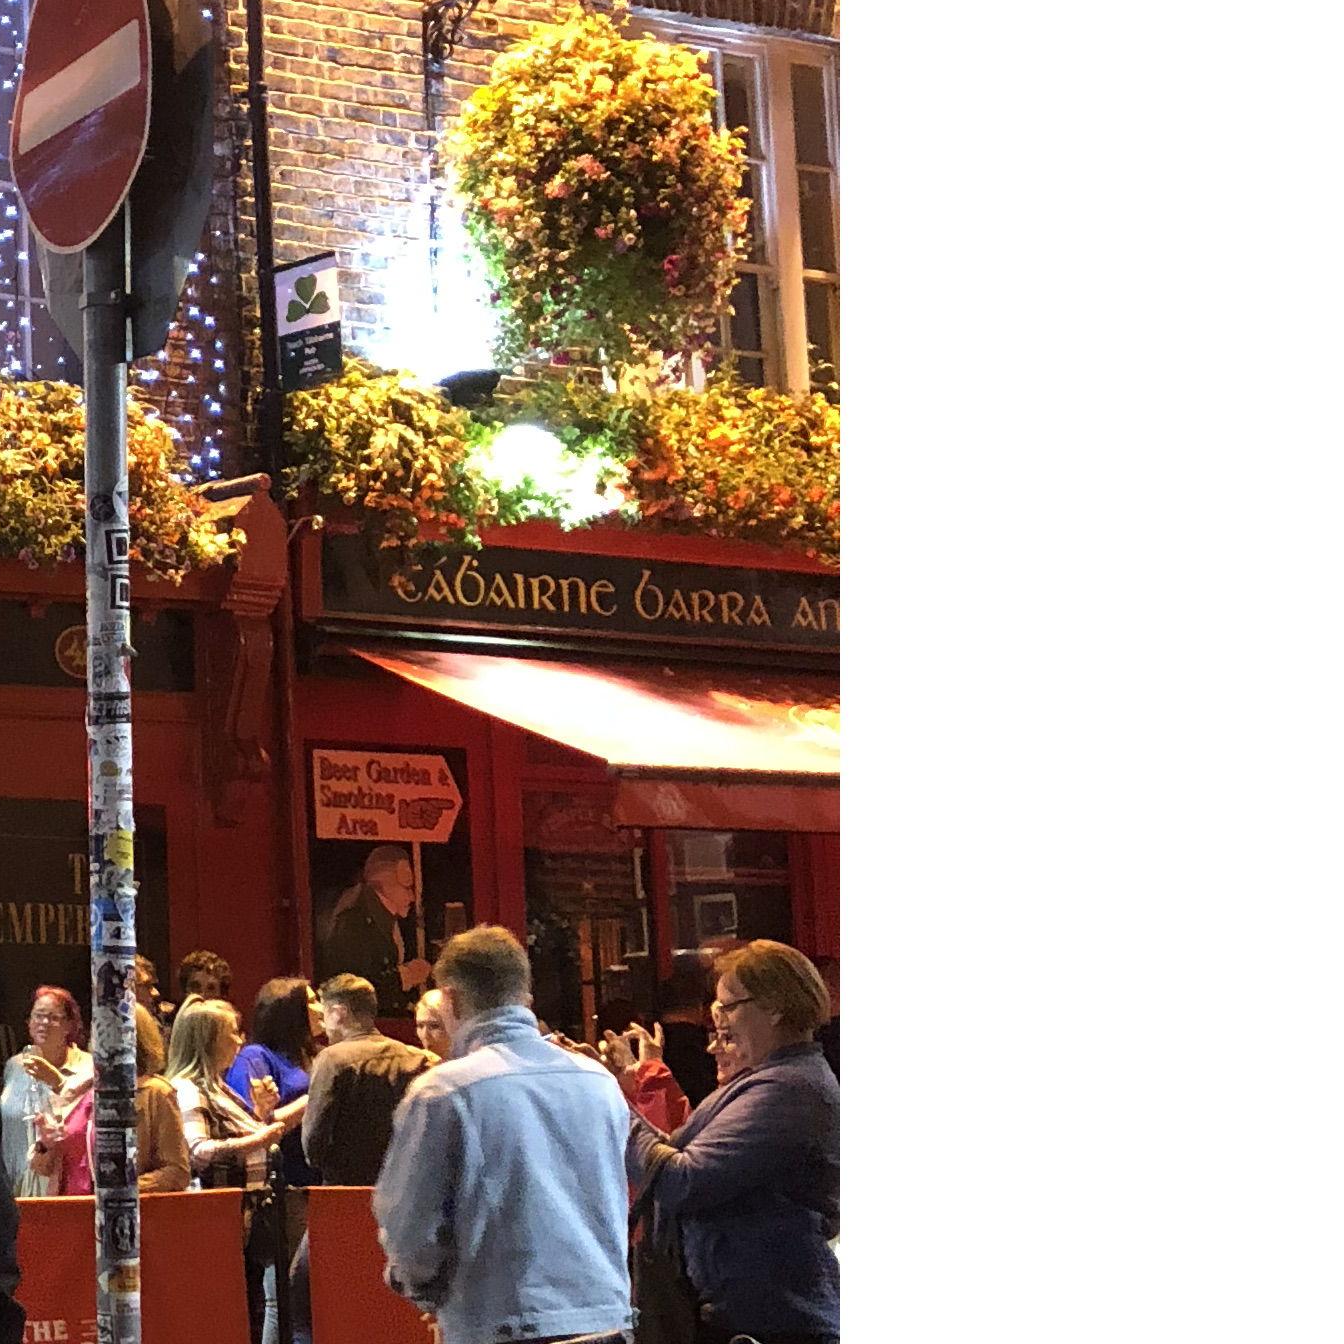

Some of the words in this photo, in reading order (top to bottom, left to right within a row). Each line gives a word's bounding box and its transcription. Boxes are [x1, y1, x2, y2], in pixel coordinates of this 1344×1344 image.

[319, 757, 360, 782] Beer
[366, 758, 432, 786] Garden
[320, 785, 396, 814] Smoking
[336, 813, 379, 836] Area
[23, 1319, 69, 1343] THE
